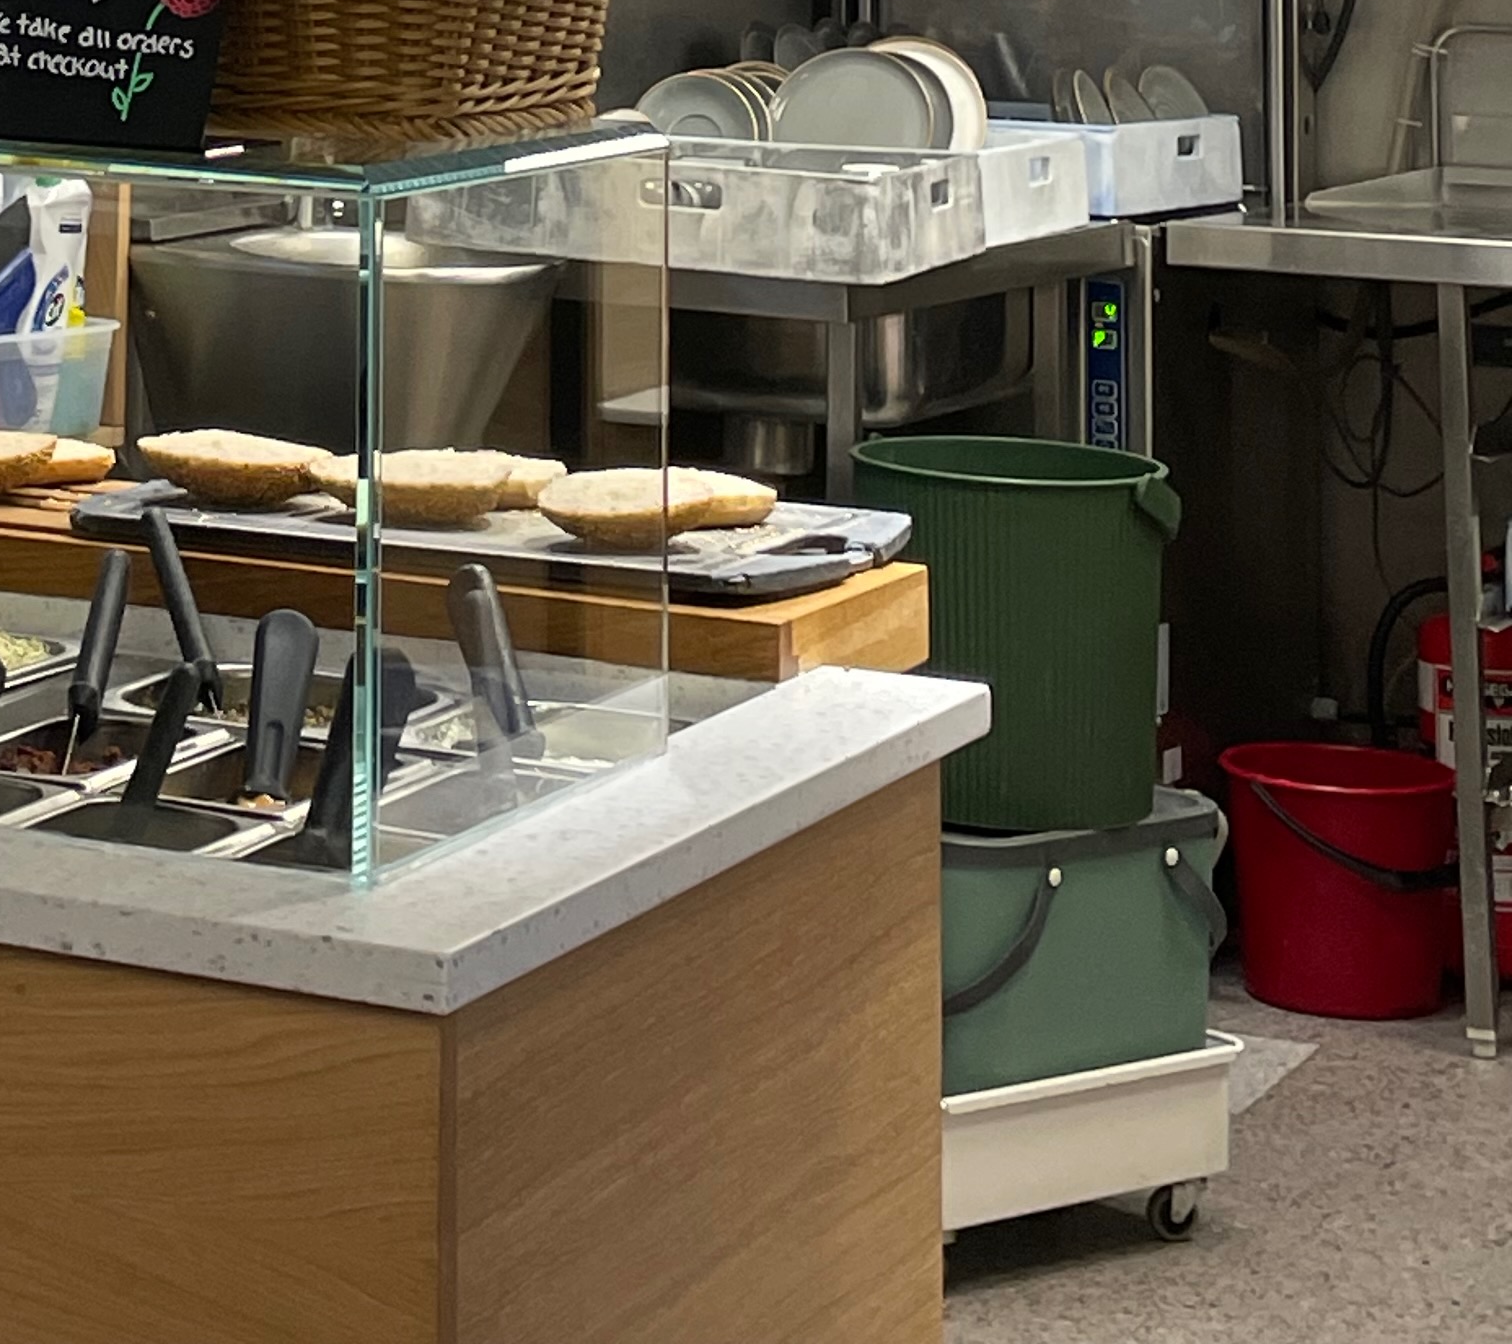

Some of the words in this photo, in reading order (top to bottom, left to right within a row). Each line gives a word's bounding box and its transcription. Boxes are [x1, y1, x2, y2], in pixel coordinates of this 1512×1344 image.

[15, 12, 72, 44] take
[78, 25, 111, 49] all
[117, 31, 195, 58] orders
[27, 50, 130, 81] checkout
